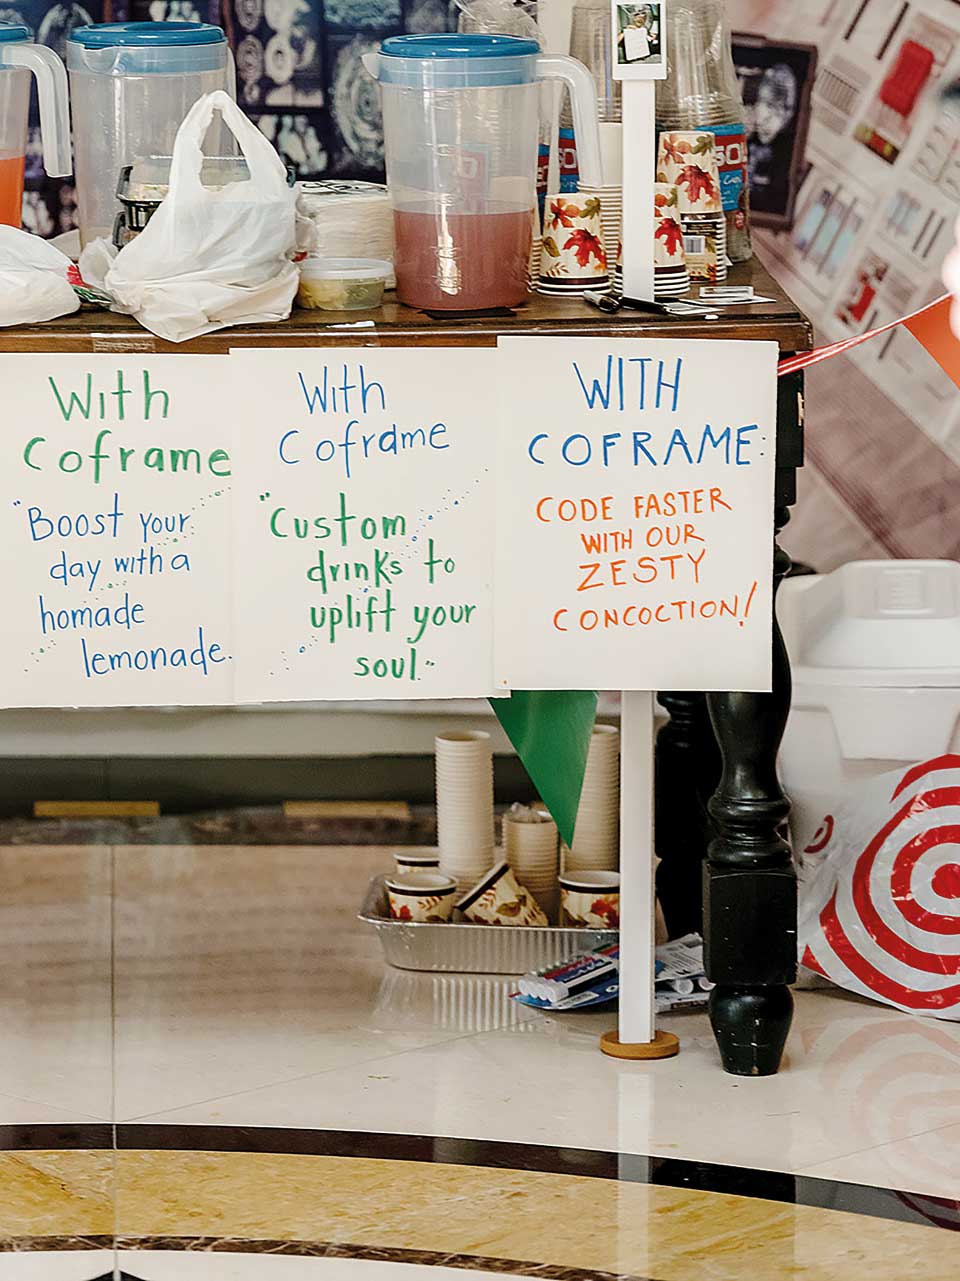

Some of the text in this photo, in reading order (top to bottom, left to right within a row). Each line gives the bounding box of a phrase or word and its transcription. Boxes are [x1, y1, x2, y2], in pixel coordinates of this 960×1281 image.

[48, 369, 170, 421] With
[298, 364, 386, 415] With
[573, 354, 683, 412] WITH
[23, 429, 232, 485] Coframe
[279, 420, 450, 479] Coframe
[139, 512, 192, 543] your
[536, 487, 733, 523] CODE FASTER
[424, 537, 456, 584] to
[580, 523, 706, 555] WITH OUR
[49, 546, 191, 592] day with a
[576, 548, 706, 593] ZESTY
[39, 592, 145, 635] homade
[310, 588, 477, 644] uplift your
[553, 580, 759, 632] CONCOCTION!
